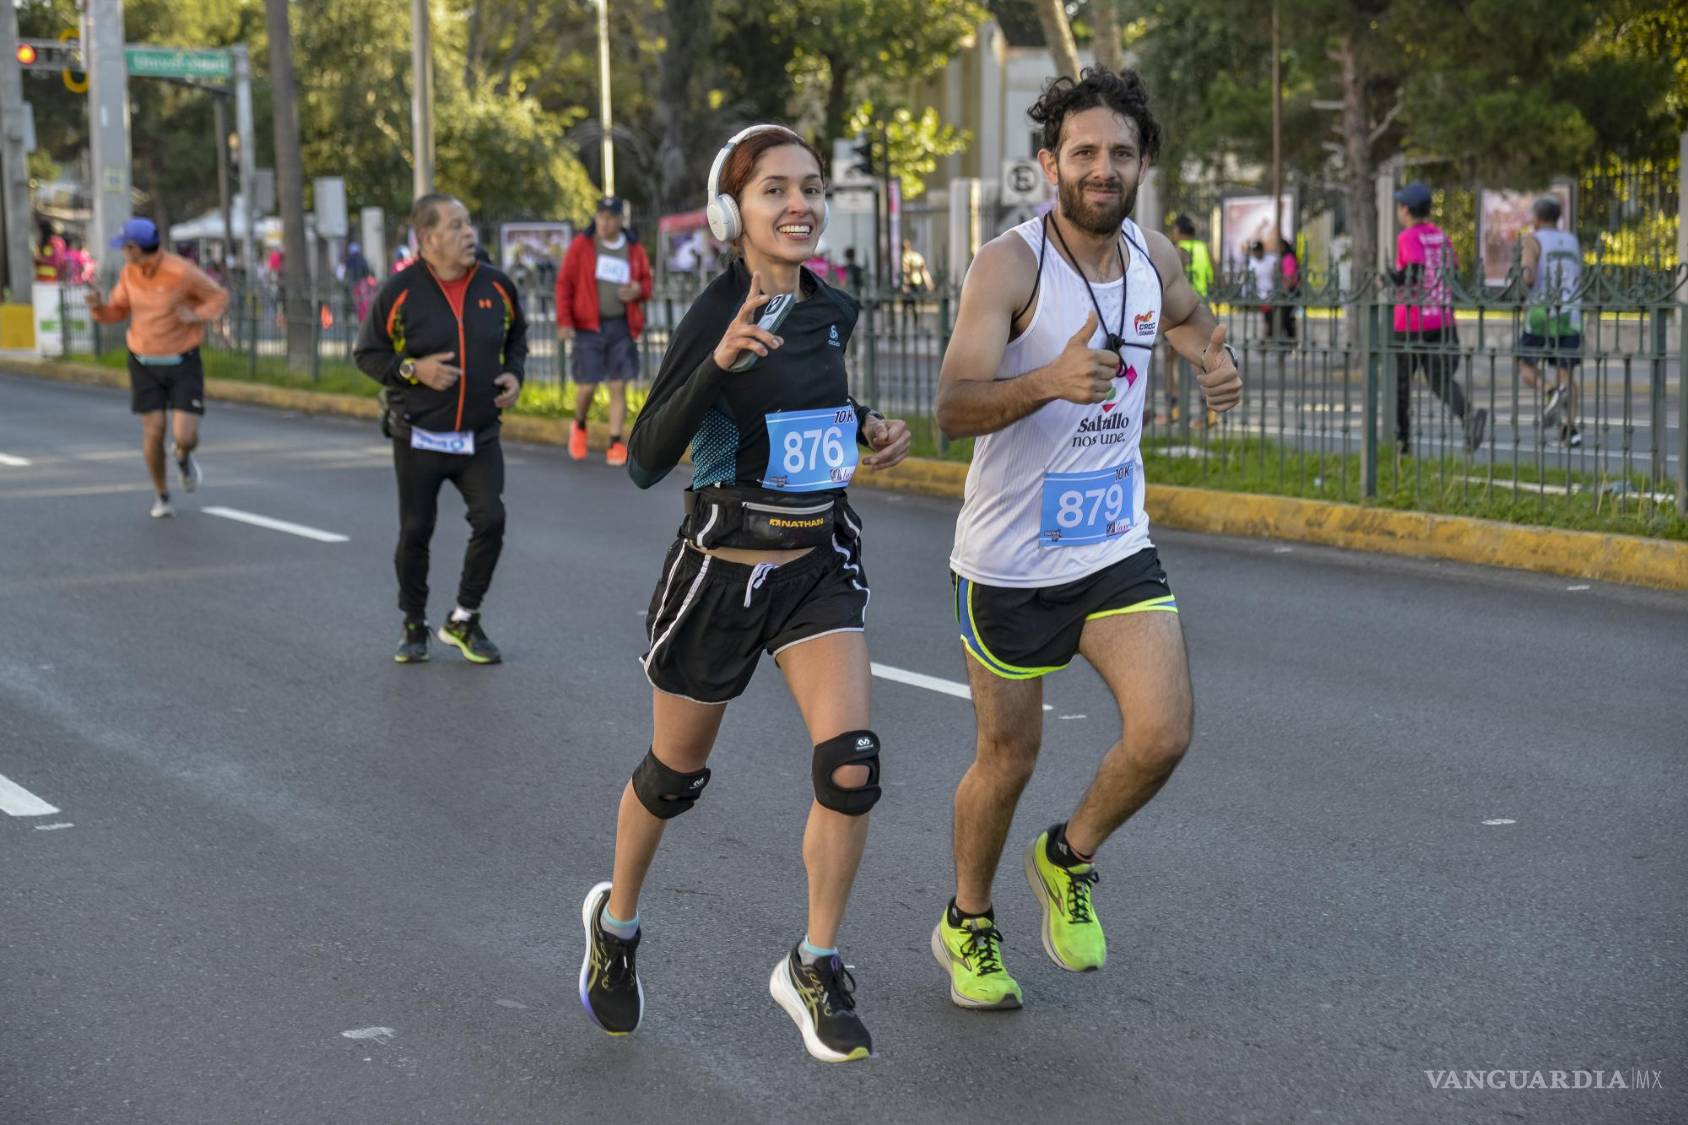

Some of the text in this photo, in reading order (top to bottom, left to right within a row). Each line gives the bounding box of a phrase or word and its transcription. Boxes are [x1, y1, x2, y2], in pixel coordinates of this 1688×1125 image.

[1014, 166, 1033, 192] E
[1077, 412, 1130, 433] Saltillo
[783, 426, 844, 475] 876
[1072, 432, 1126, 448] nos une.
[1056, 483, 1124, 530] 879
[781, 517, 825, 529] NATHAN
